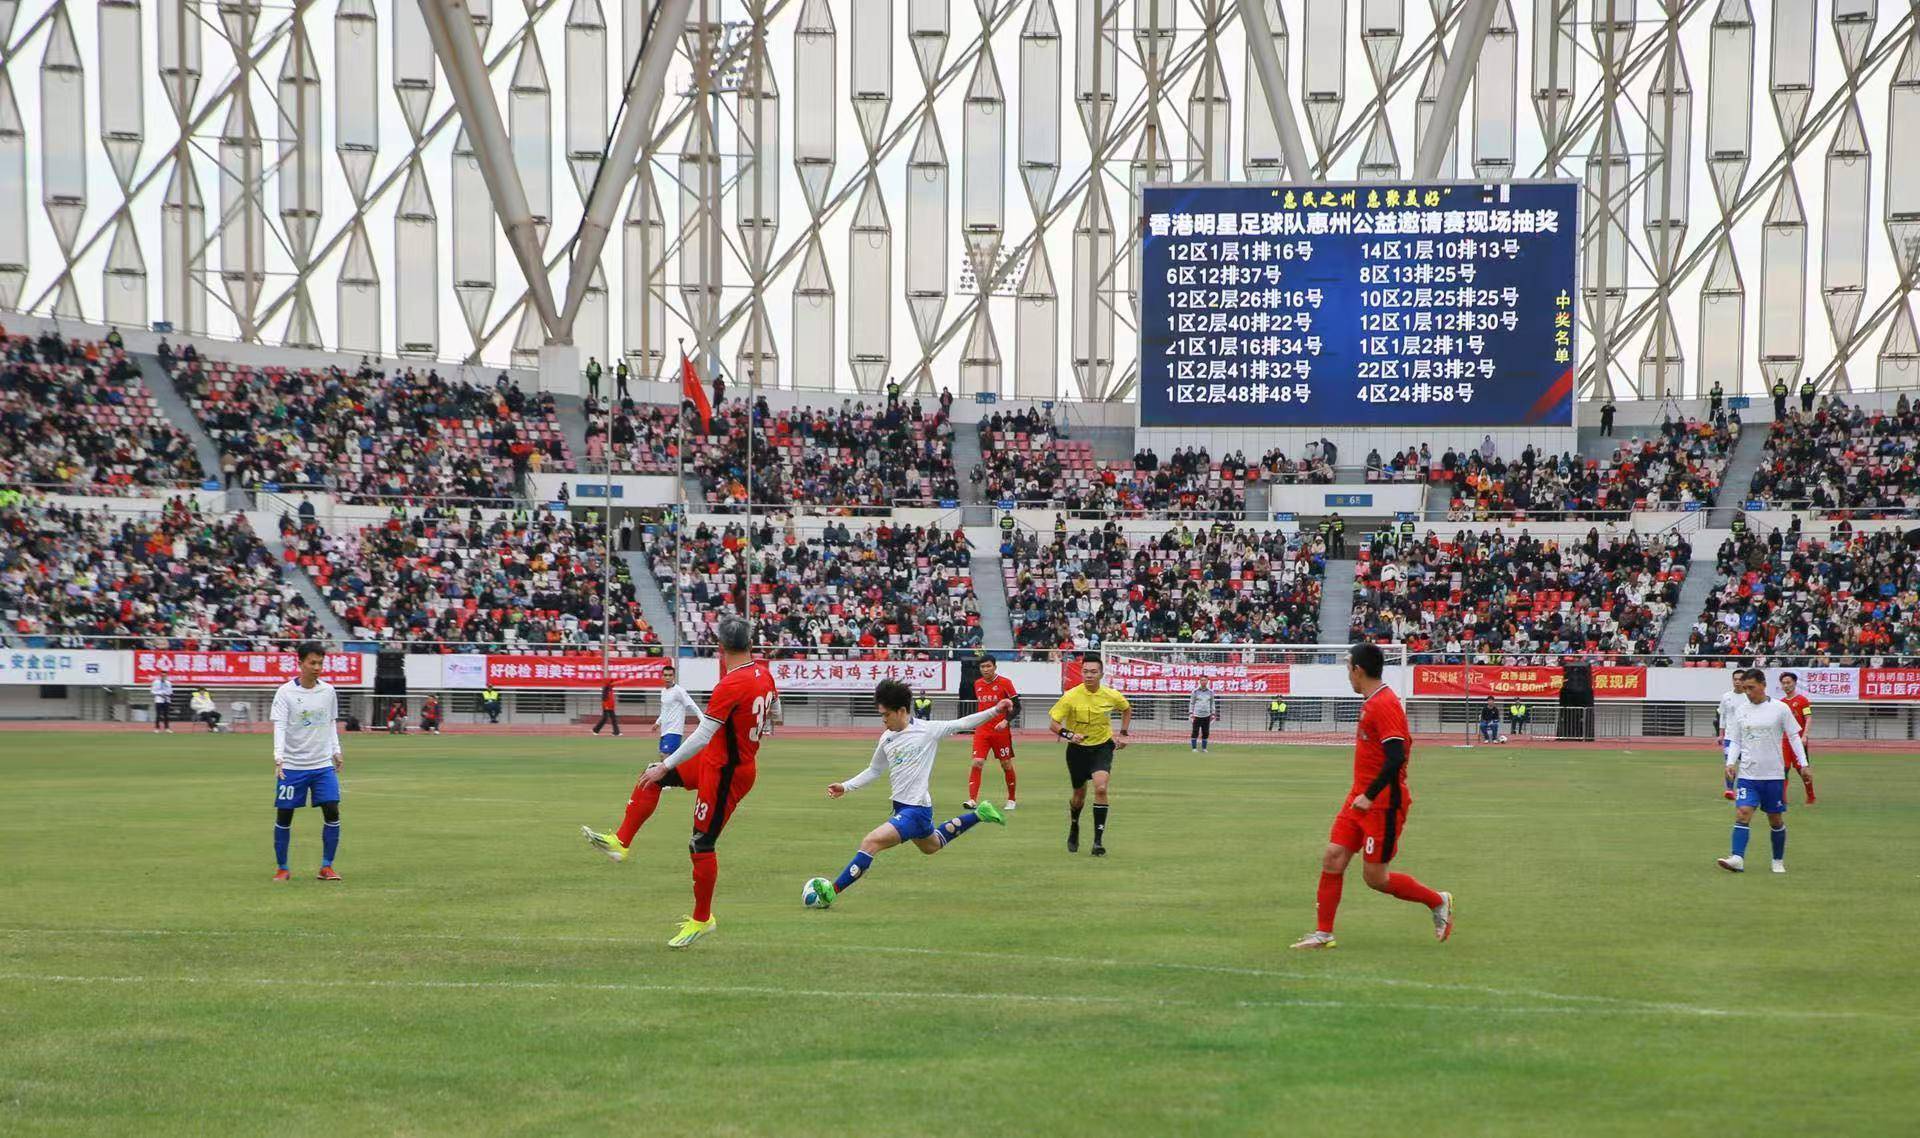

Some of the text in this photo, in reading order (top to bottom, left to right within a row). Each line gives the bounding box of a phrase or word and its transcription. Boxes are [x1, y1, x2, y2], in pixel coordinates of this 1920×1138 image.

[1149, 209, 1559, 237] 香港明星足球队惠州公益邀请赛现场抽奖
[1168, 240, 1314, 261] 12区1层1排16号
[1361, 239, 1520, 260] 14区1层10排13号
[1167, 265, 1281, 285] 6区12排37号
[1360, 263, 1477, 284] 8区13排25号
[1168, 288, 1324, 309] 12区2层26排16号
[1360, 287, 1519, 308] 10区2层25排25号
[1167, 312, 1313, 332] 1区2层40排22号
[1360, 311, 1519, 332] 12区1层12排30号
[1555, 289, 1570, 363] 中奖名单
[1359, 335, 1485, 356] 1区1层2排1号
[1166, 359, 1312, 380] 1区2层41排32号
[1358, 359, 1496, 379] 22区1层3排2号
[1166, 383, 1312, 403] 1区2层48排48号
[1357, 383, 1475, 403] 4区24排58号
[11, 653, 71, 669] 安全出口
[489, 663, 532, 678] 好体检
[534, 664, 576, 678] 到美年
[26, 671, 56, 680] EXIT
[867, 664, 936, 680] 手作点心
[1865, 682, 1920, 695] 口腔医疗
[1000, 747, 1010, 757] 39
[278, 785, 295, 800] 20
[1365, 836, 1375, 854] 8
